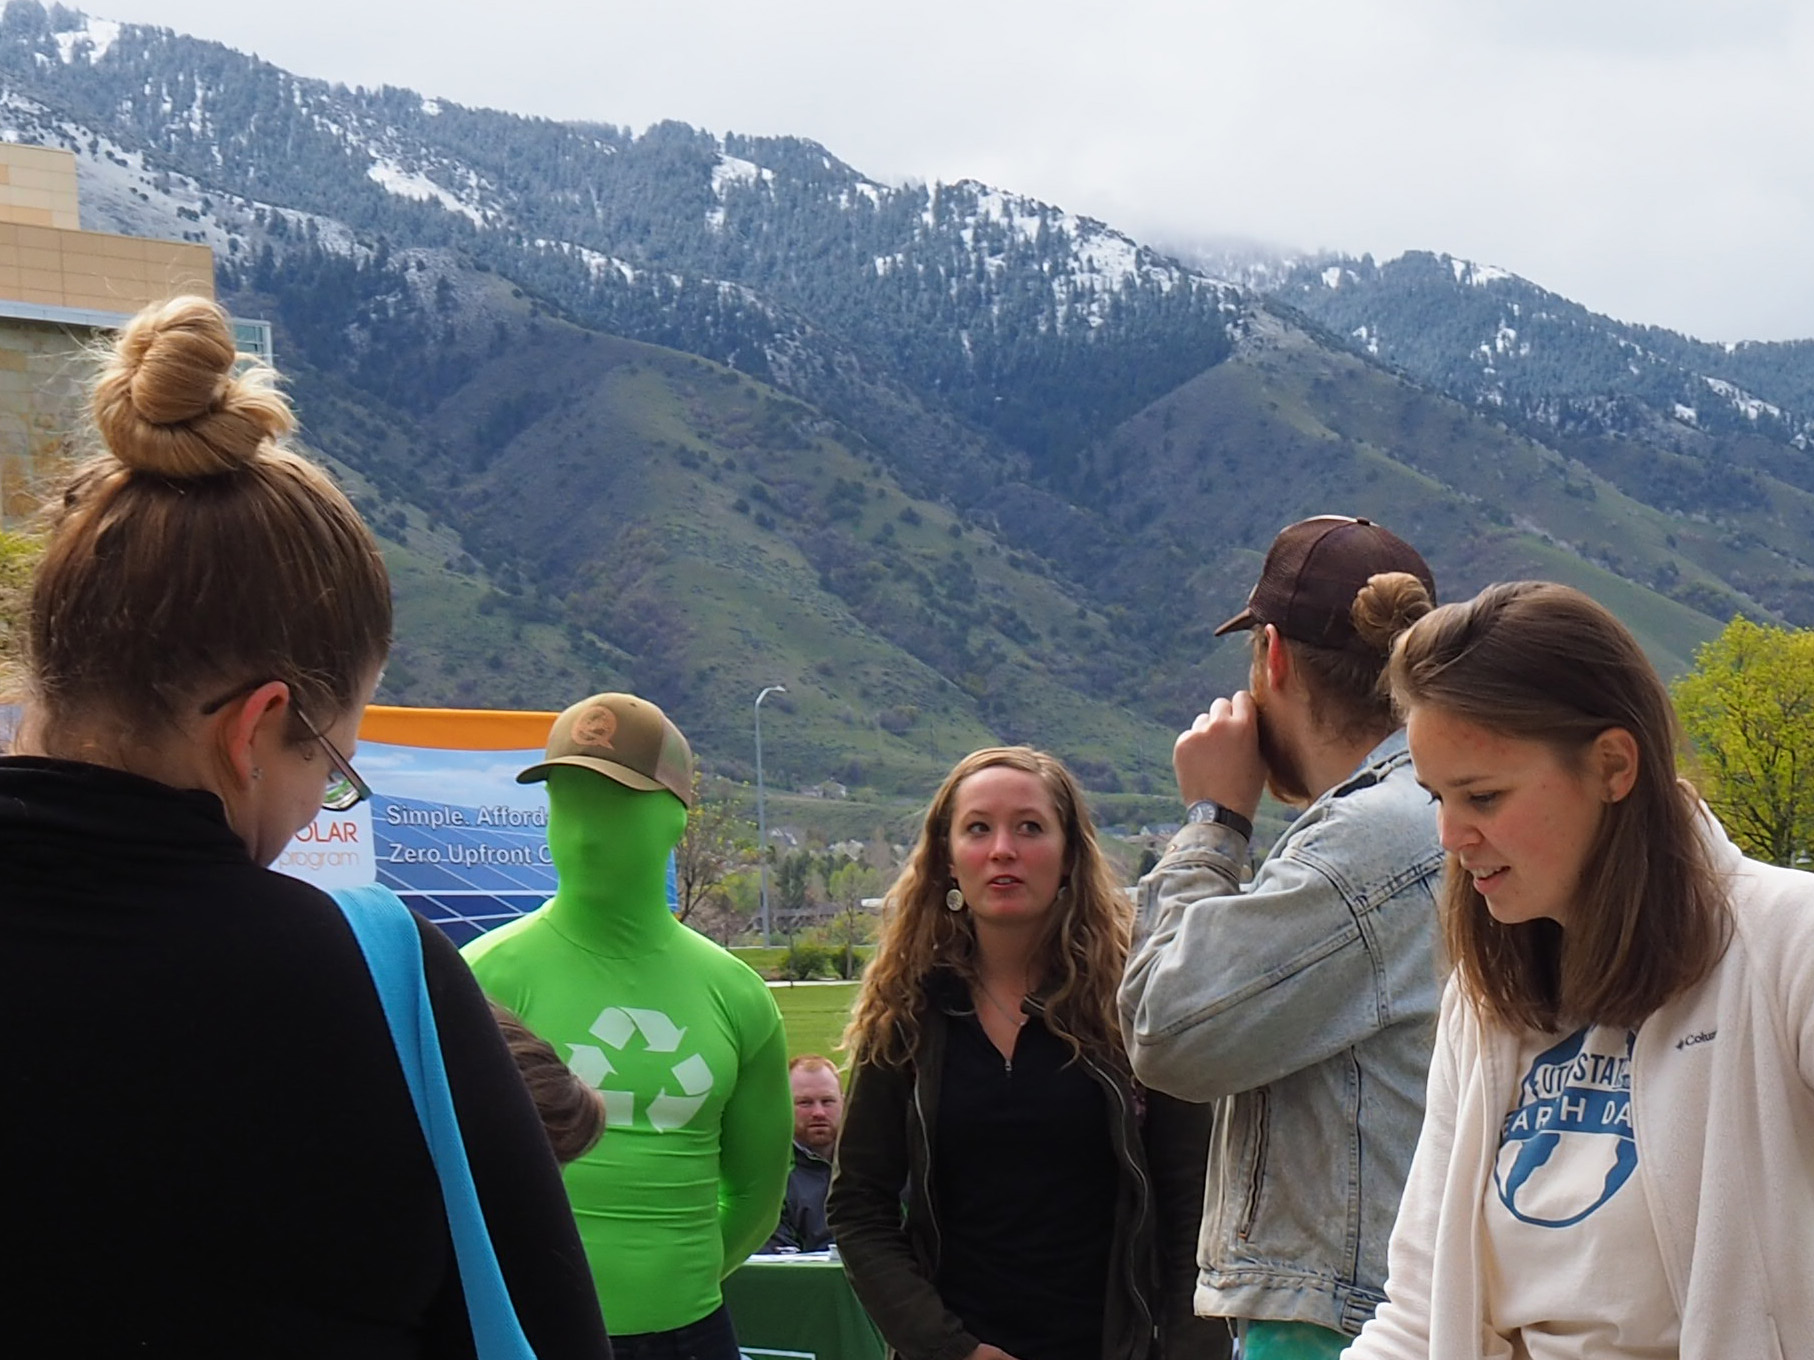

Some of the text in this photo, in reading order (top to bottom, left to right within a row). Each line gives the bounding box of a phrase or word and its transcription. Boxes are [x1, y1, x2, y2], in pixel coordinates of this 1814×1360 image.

[387, 806, 550, 830] Simple. Afford
[279, 852, 359, 871] program
[390, 844, 441, 864] Zero
[448, 845, 532, 868] Upfront
